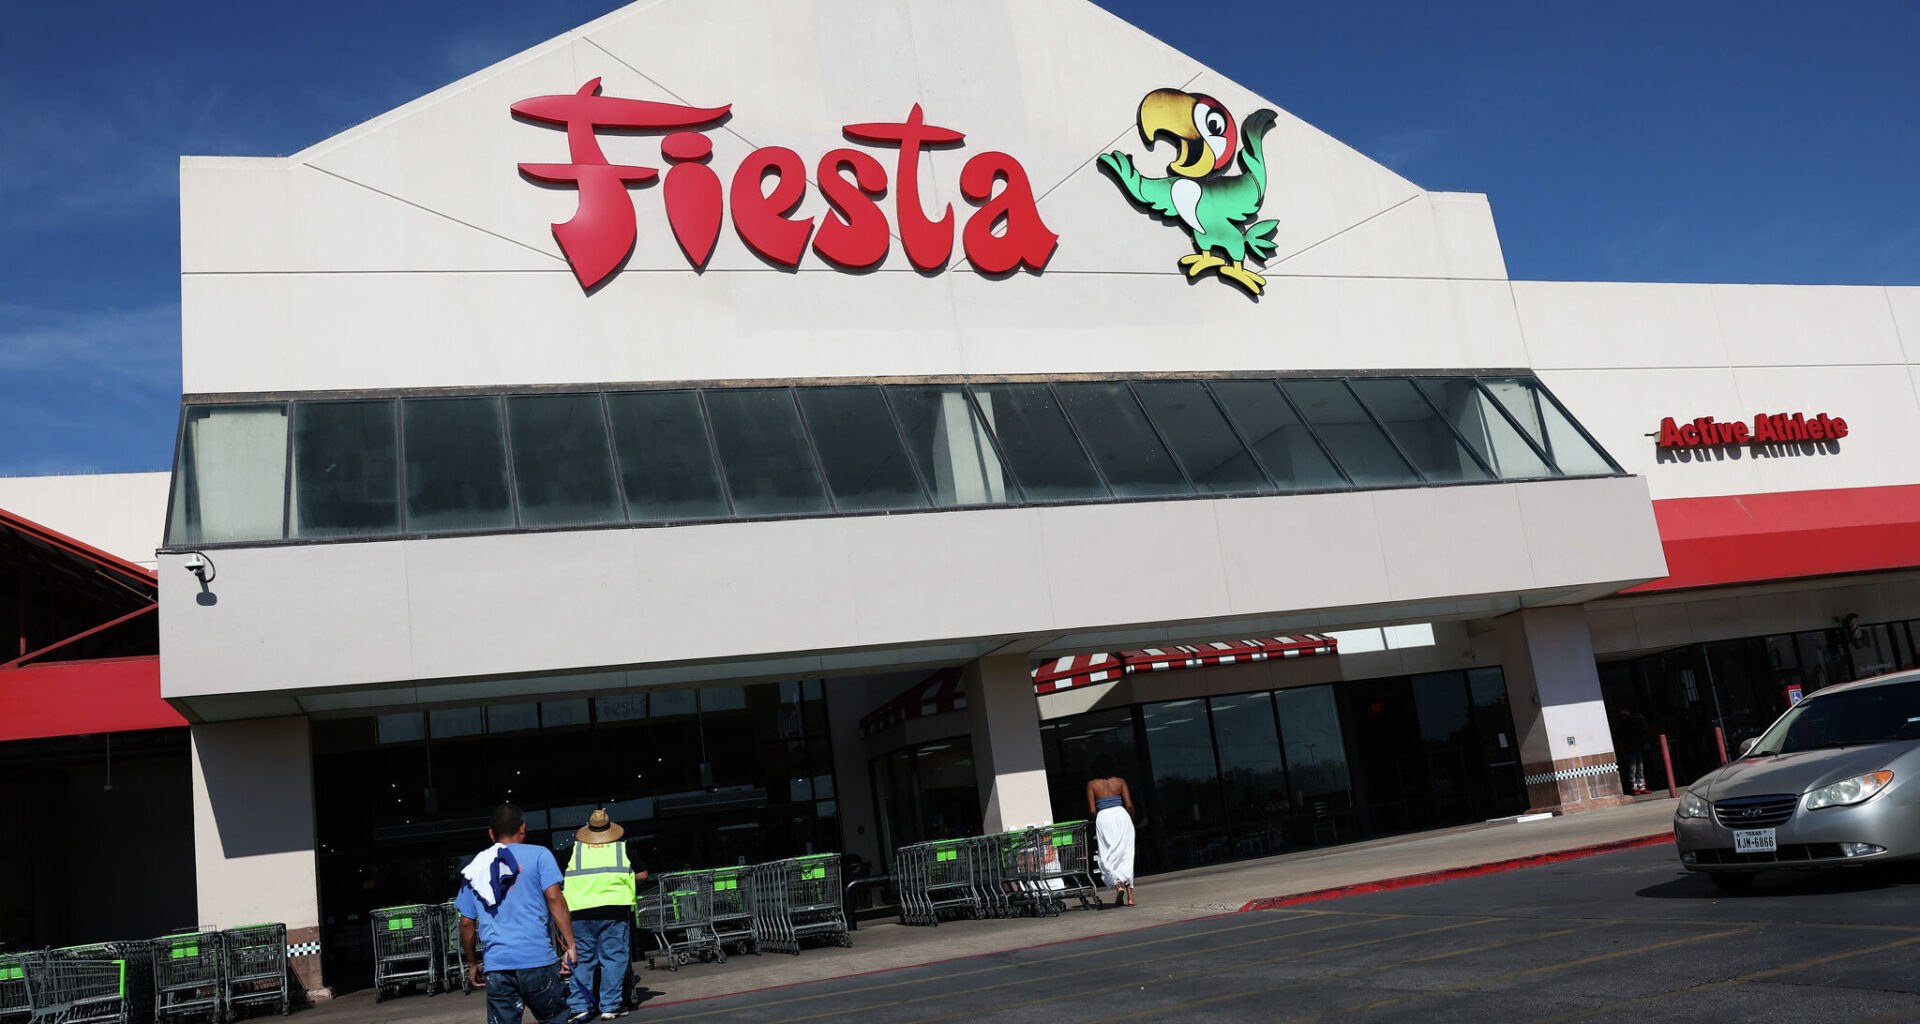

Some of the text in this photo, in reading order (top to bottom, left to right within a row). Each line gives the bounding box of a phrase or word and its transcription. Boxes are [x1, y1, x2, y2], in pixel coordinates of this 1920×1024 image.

[510, 76, 1059, 290] Fiesta
[1659, 412, 1849, 447] Active Athlete
